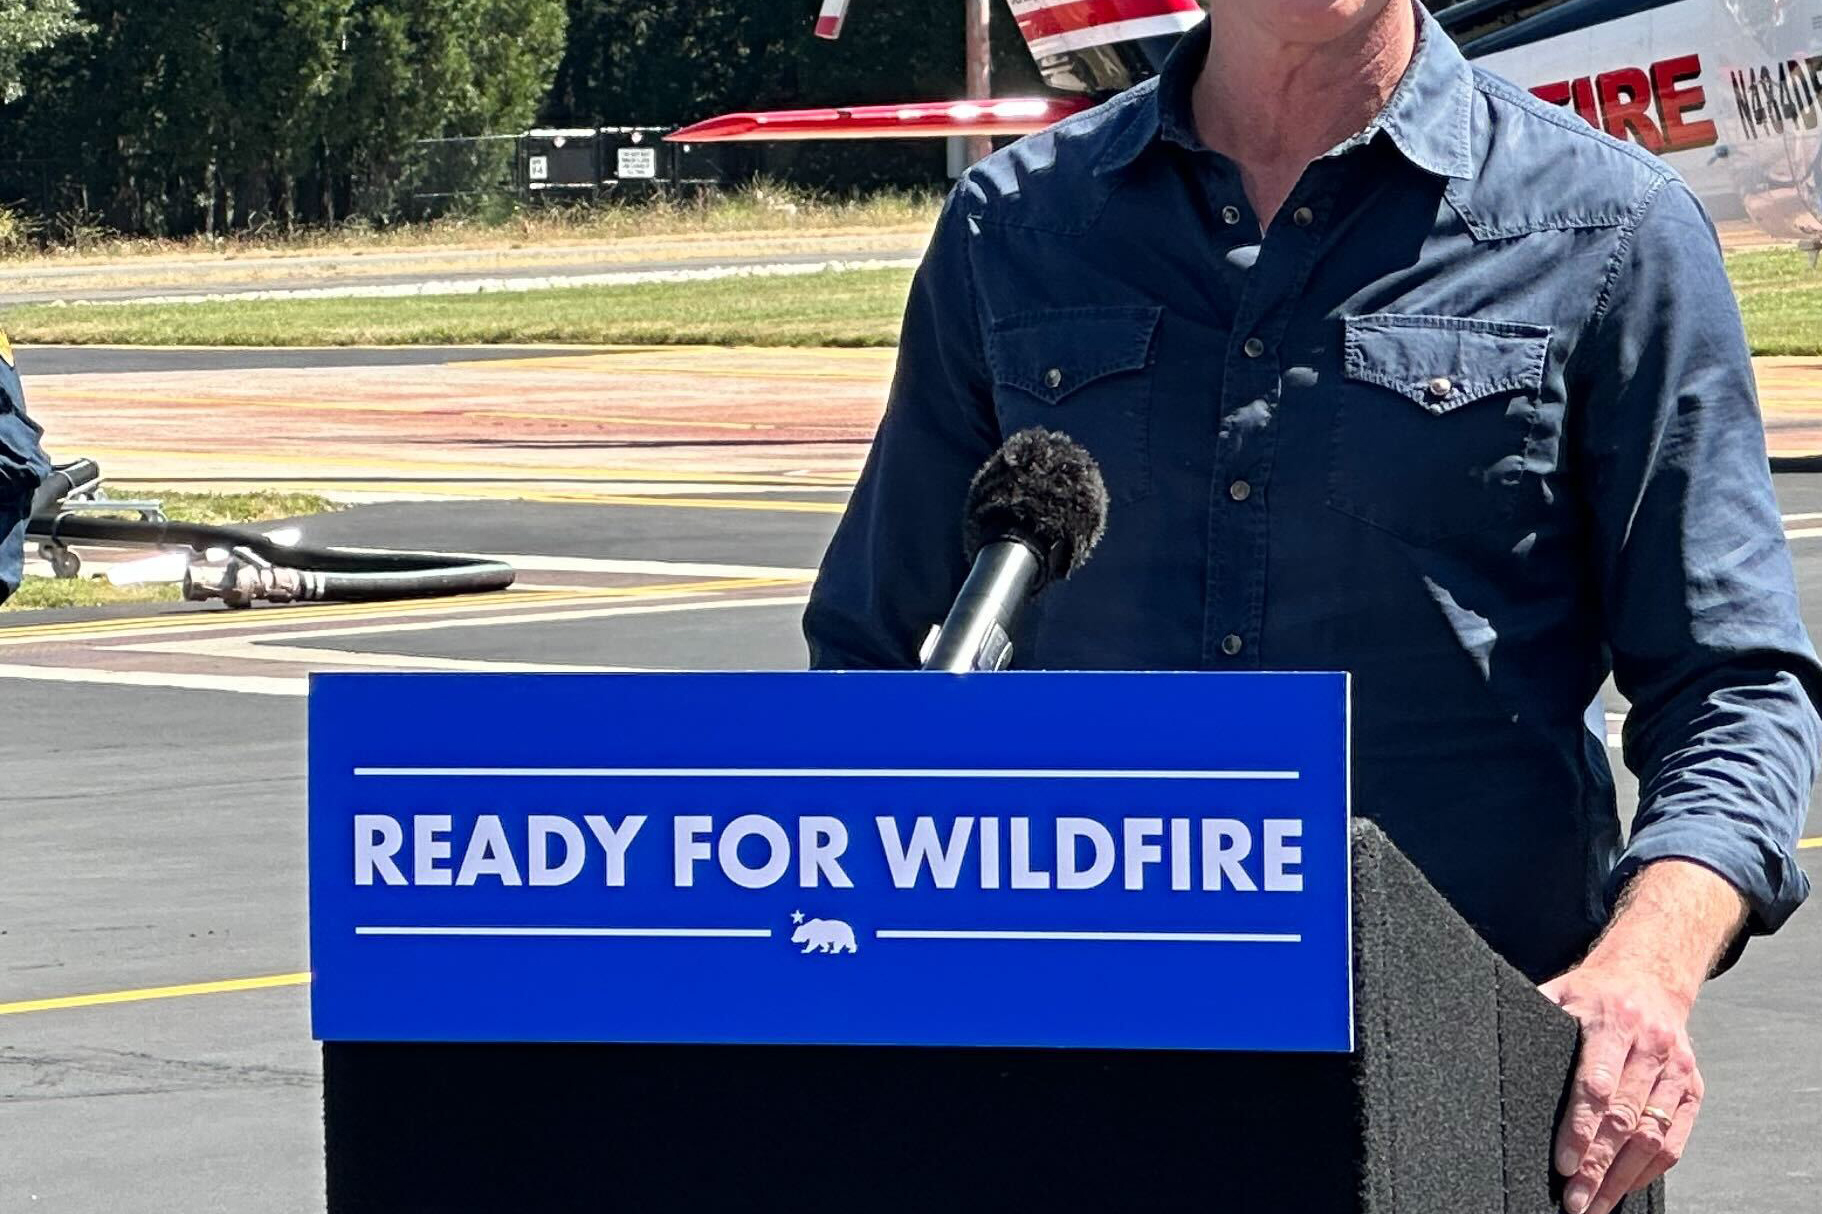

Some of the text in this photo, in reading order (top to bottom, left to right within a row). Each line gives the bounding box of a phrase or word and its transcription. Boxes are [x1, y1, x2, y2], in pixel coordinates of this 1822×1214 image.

[353, 814, 1304, 892] READY FOR WILDFIRE
